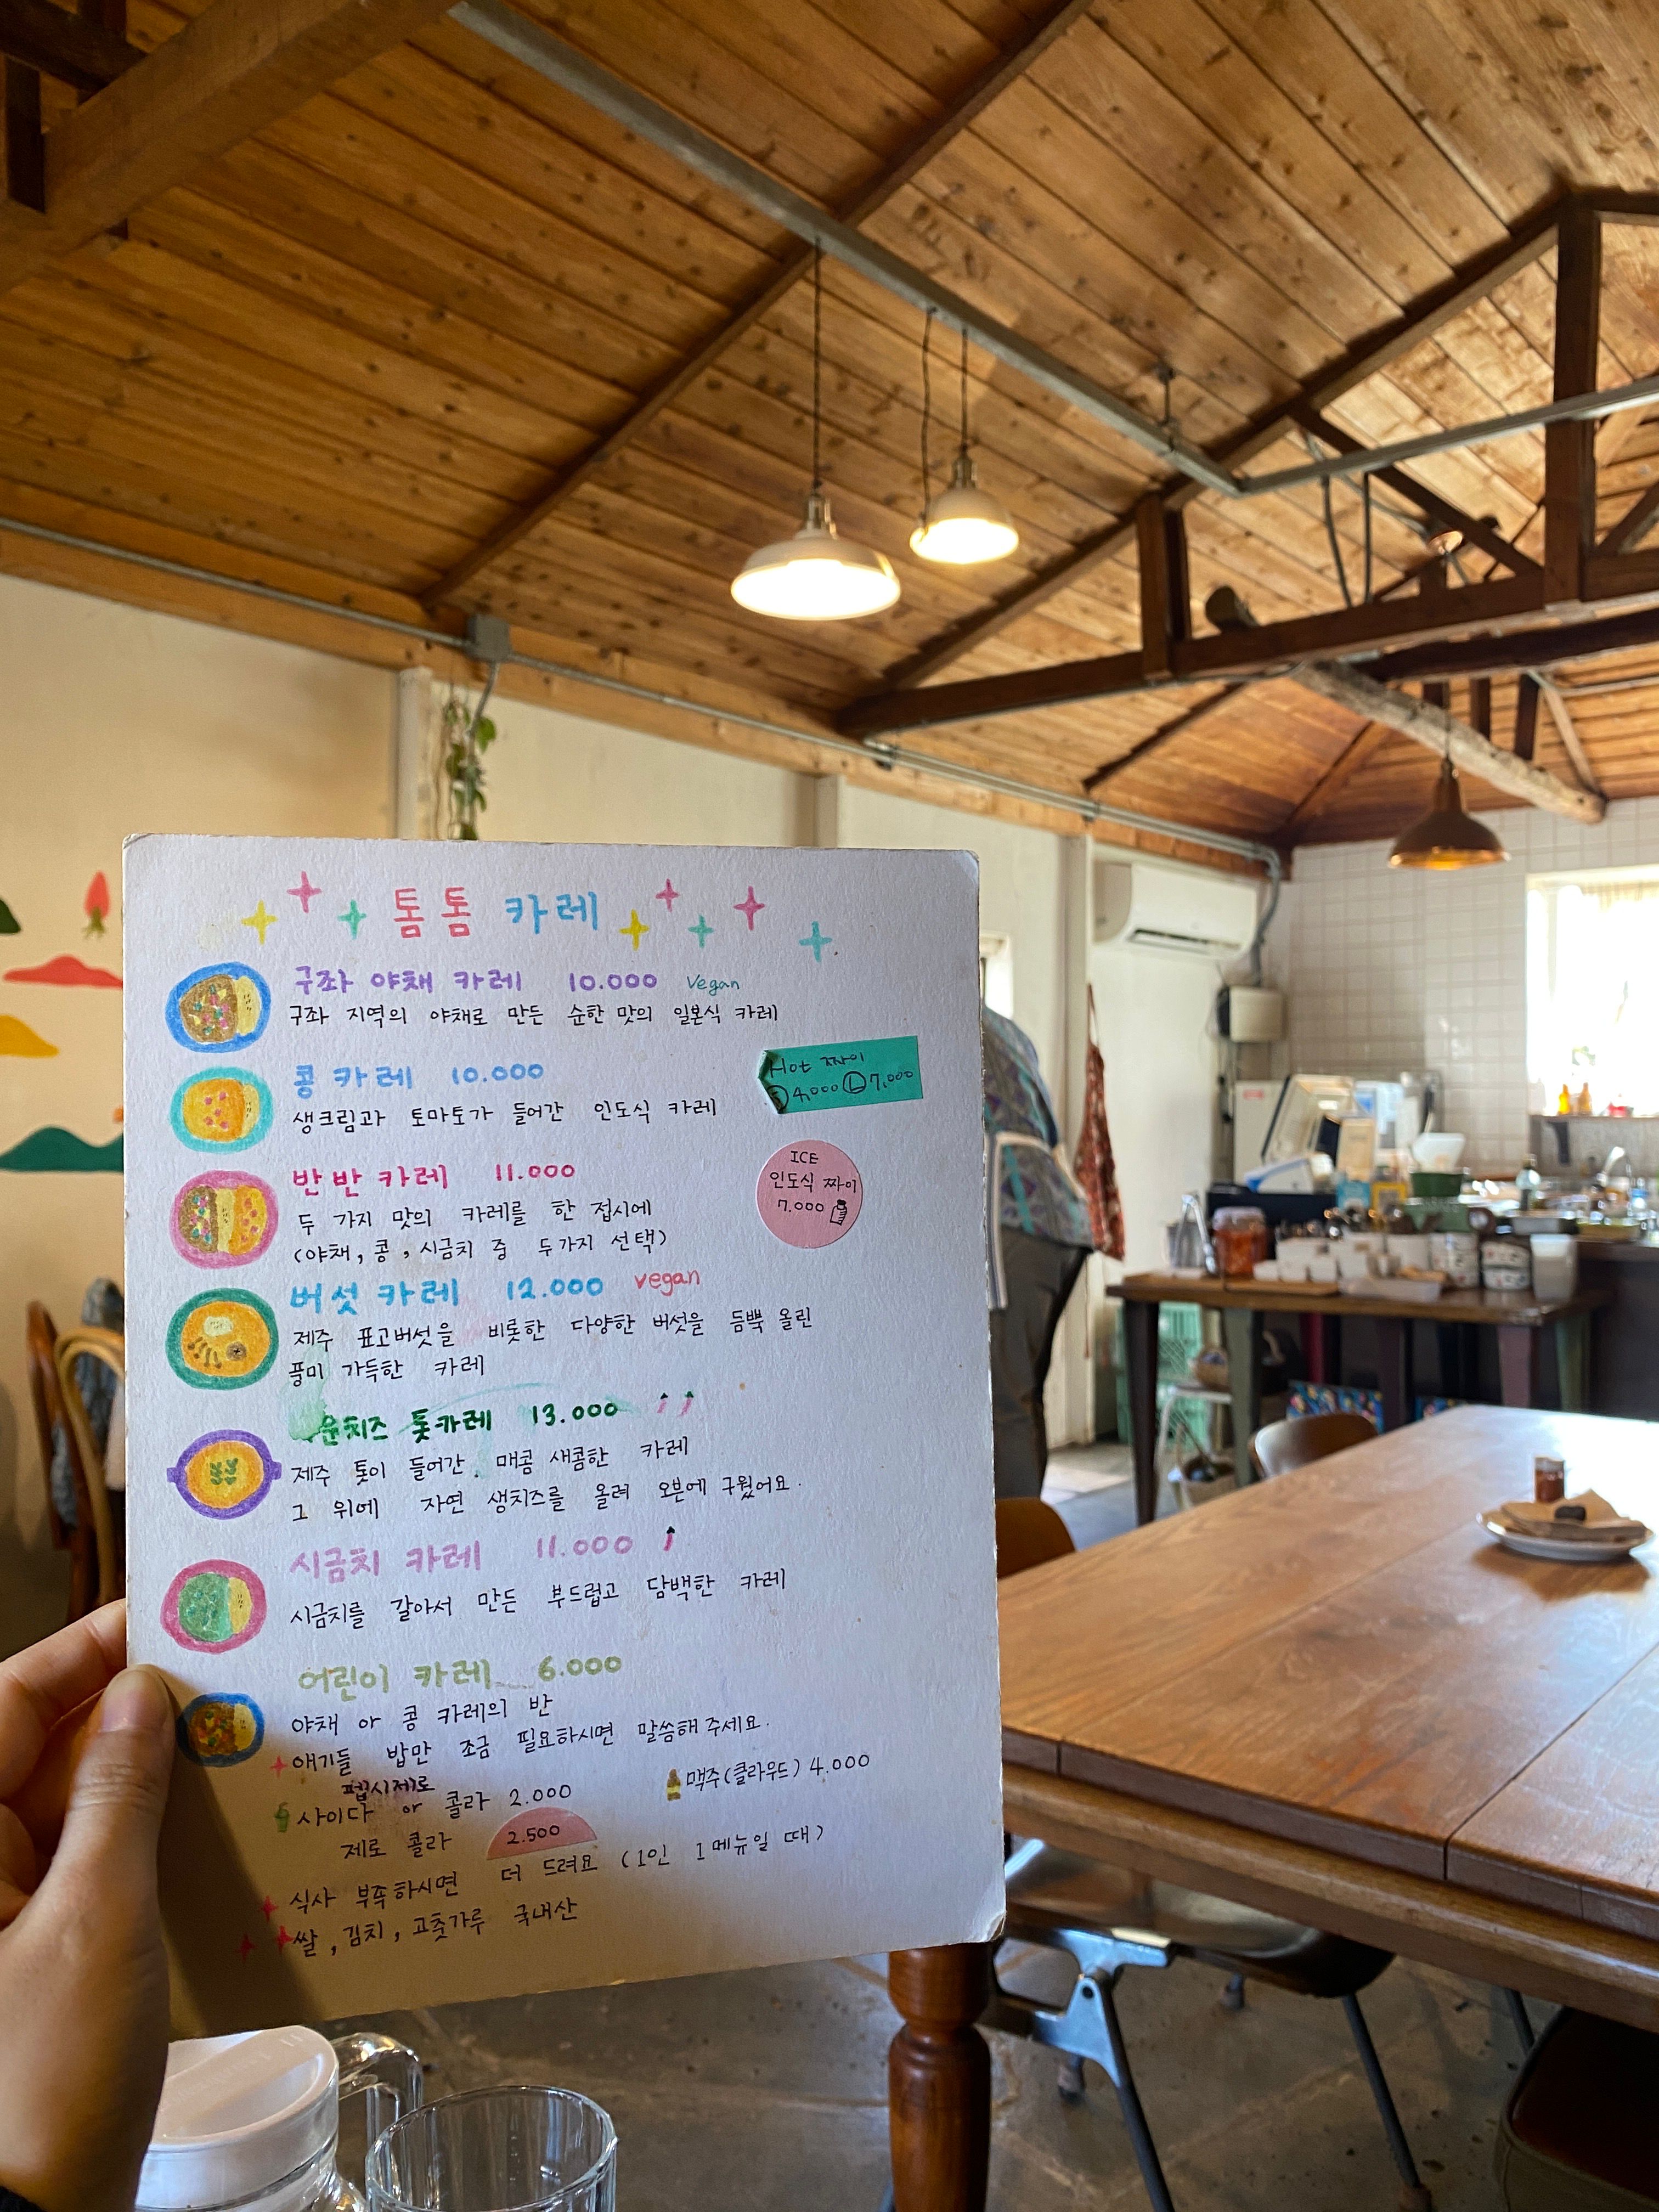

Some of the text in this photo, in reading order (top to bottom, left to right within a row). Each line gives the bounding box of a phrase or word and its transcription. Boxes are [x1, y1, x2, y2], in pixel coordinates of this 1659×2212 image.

[505, 891, 597, 934] 카레
[295, 966, 740, 996] 구좌 야채 카레 10.000 Vegan
[289, 1004, 777, 1029] 구좌 지역의 야채로 만든 순한 맛의 일본식 카레
[294, 1064, 544, 1099] 콩 카레 10.000
[770, 1058, 812, 1077] Hot
[292, 1098, 716, 1135] 생크림과 토마토가 들어간 인도식 카레
[378, 1164, 448, 1189] 카레
[495, 1163, 575, 1182] 11.000
[790, 1150, 819, 1164] ICE
[770, 1171, 814, 1193] 인도식
[298, 1198, 651, 1236] 두 가지 맛의 카레를 한 접시에
[777, 1199, 824, 1213] 7.000
[420, 1237, 472, 1260] 시금치
[492, 1238, 506, 1261] 중
[290, 1270, 700, 1315] 버섯 카레 12.000 vegan
[294, 1329, 334, 1352] 제주
[488, 1318, 545, 1345] 비롯한
[571, 1314, 636, 1335] 다양한
[653, 1311, 704, 1336] 버섯을
[730, 1308, 764, 1334] 듬뿍
[778, 1306, 812, 1331] 올린
[289, 1354, 484, 1387] 풍미 가득한 카레
[318, 1414, 388, 1447] 운치즈
[530, 1402, 618, 1426] 13.000
[291, 1436, 688, 1487] 제주 톳이 들어간 매콤 새콤한 카레
[292, 1504, 308, 1522] 그
[334, 1497, 379, 1520] 위에
[420, 1490, 464, 1515] 자연
[487, 1486, 565, 1514] 생치즈를
[595, 1483, 629, 1510] 올려
[290, 1535, 633, 1583] 시금치 카레 11.000
[290, 1568, 785, 1630] 시금치를 갈아서 만든 부드럽고 담백한 카레
[298, 1656, 621, 1702] 어린이 카레 6.000
[291, 1713, 338, 1736] 야채
[403, 1705, 417, 1731] 콩
[437, 1698, 507, 1724] 카레의
[529, 1692, 553, 1717] 반
[292, 1747, 352, 1776] 애기들
[386, 1740, 432, 1768] 밥만
[459, 1735, 489, 1759] 조금
[517, 1721, 613, 1754] 필요하시면
[810, 1754, 870, 1776] 4.000
[297, 1803, 374, 1827] 사이다
[445, 1790, 490, 1819] 콜라
[509, 1784, 571, 1807] 2.000
[340, 1831, 452, 1859] 제로 콜라
[507, 1824, 560, 1845] 2.500
[290, 1887, 336, 1914] 식사
[501, 1864, 521, 1882] 더
[544, 1853, 598, 1876] 드려요
[413, 1908, 485, 1942] 고춧가루
[514, 1897, 578, 1927] 국내산
